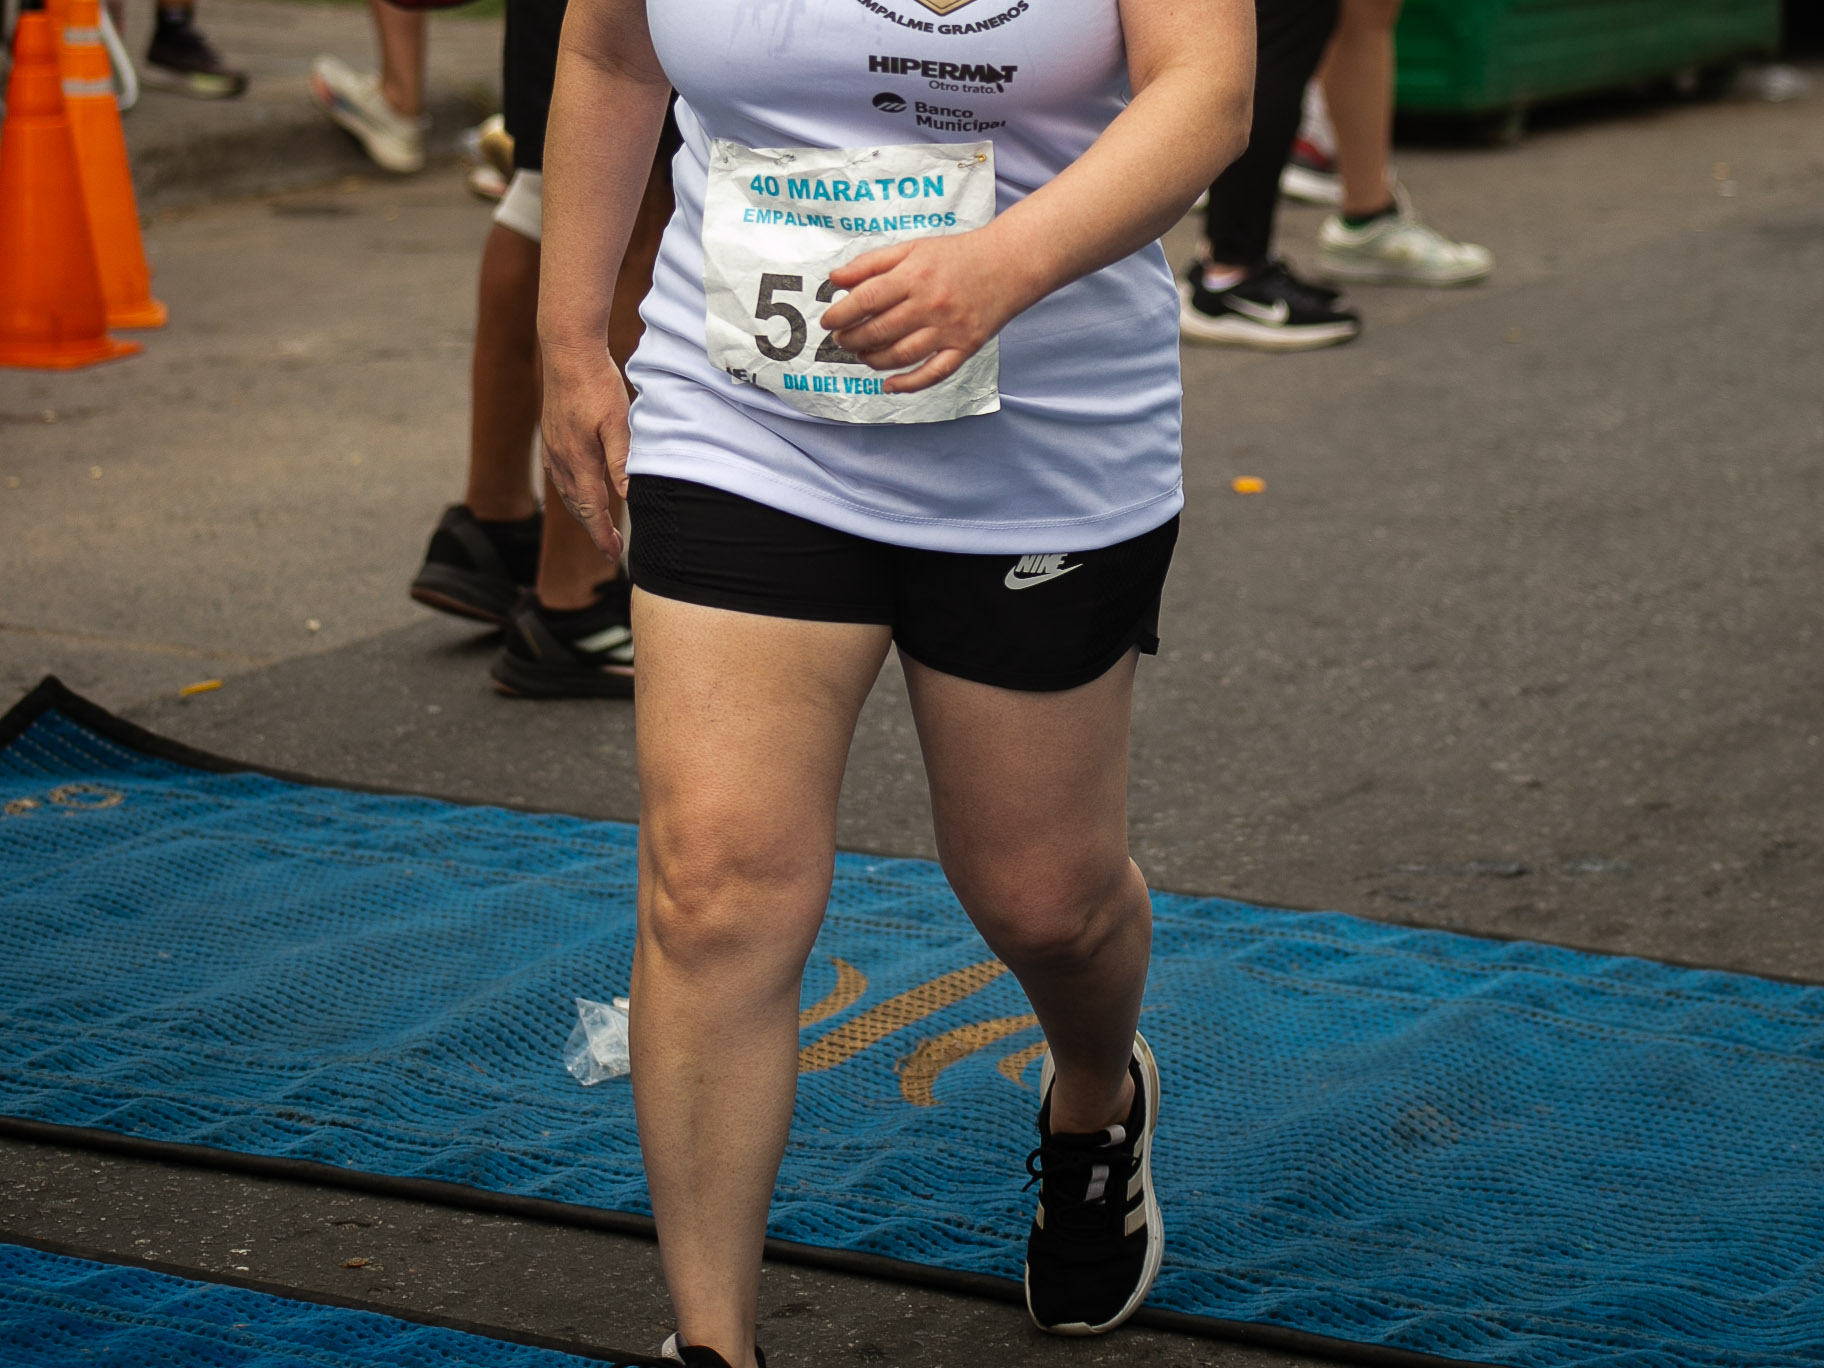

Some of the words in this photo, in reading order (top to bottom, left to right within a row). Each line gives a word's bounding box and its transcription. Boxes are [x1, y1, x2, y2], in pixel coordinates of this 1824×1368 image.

[938, 0, 1030, 35] GRANEROS
[929, 80, 959, 91] Otro
[915, 101, 973, 119] Banco
[750, 174, 780, 197] 40
[788, 175, 944, 202] MARATON
[743, 208, 834, 230] EMPALME
[841, 211, 957, 233] GRANEROS
[783, 373, 809, 392] DIA
[812, 376, 840, 393] DEL
[843, 376, 901, 395] VECI
[1015, 553, 1069, 574] NIKE
